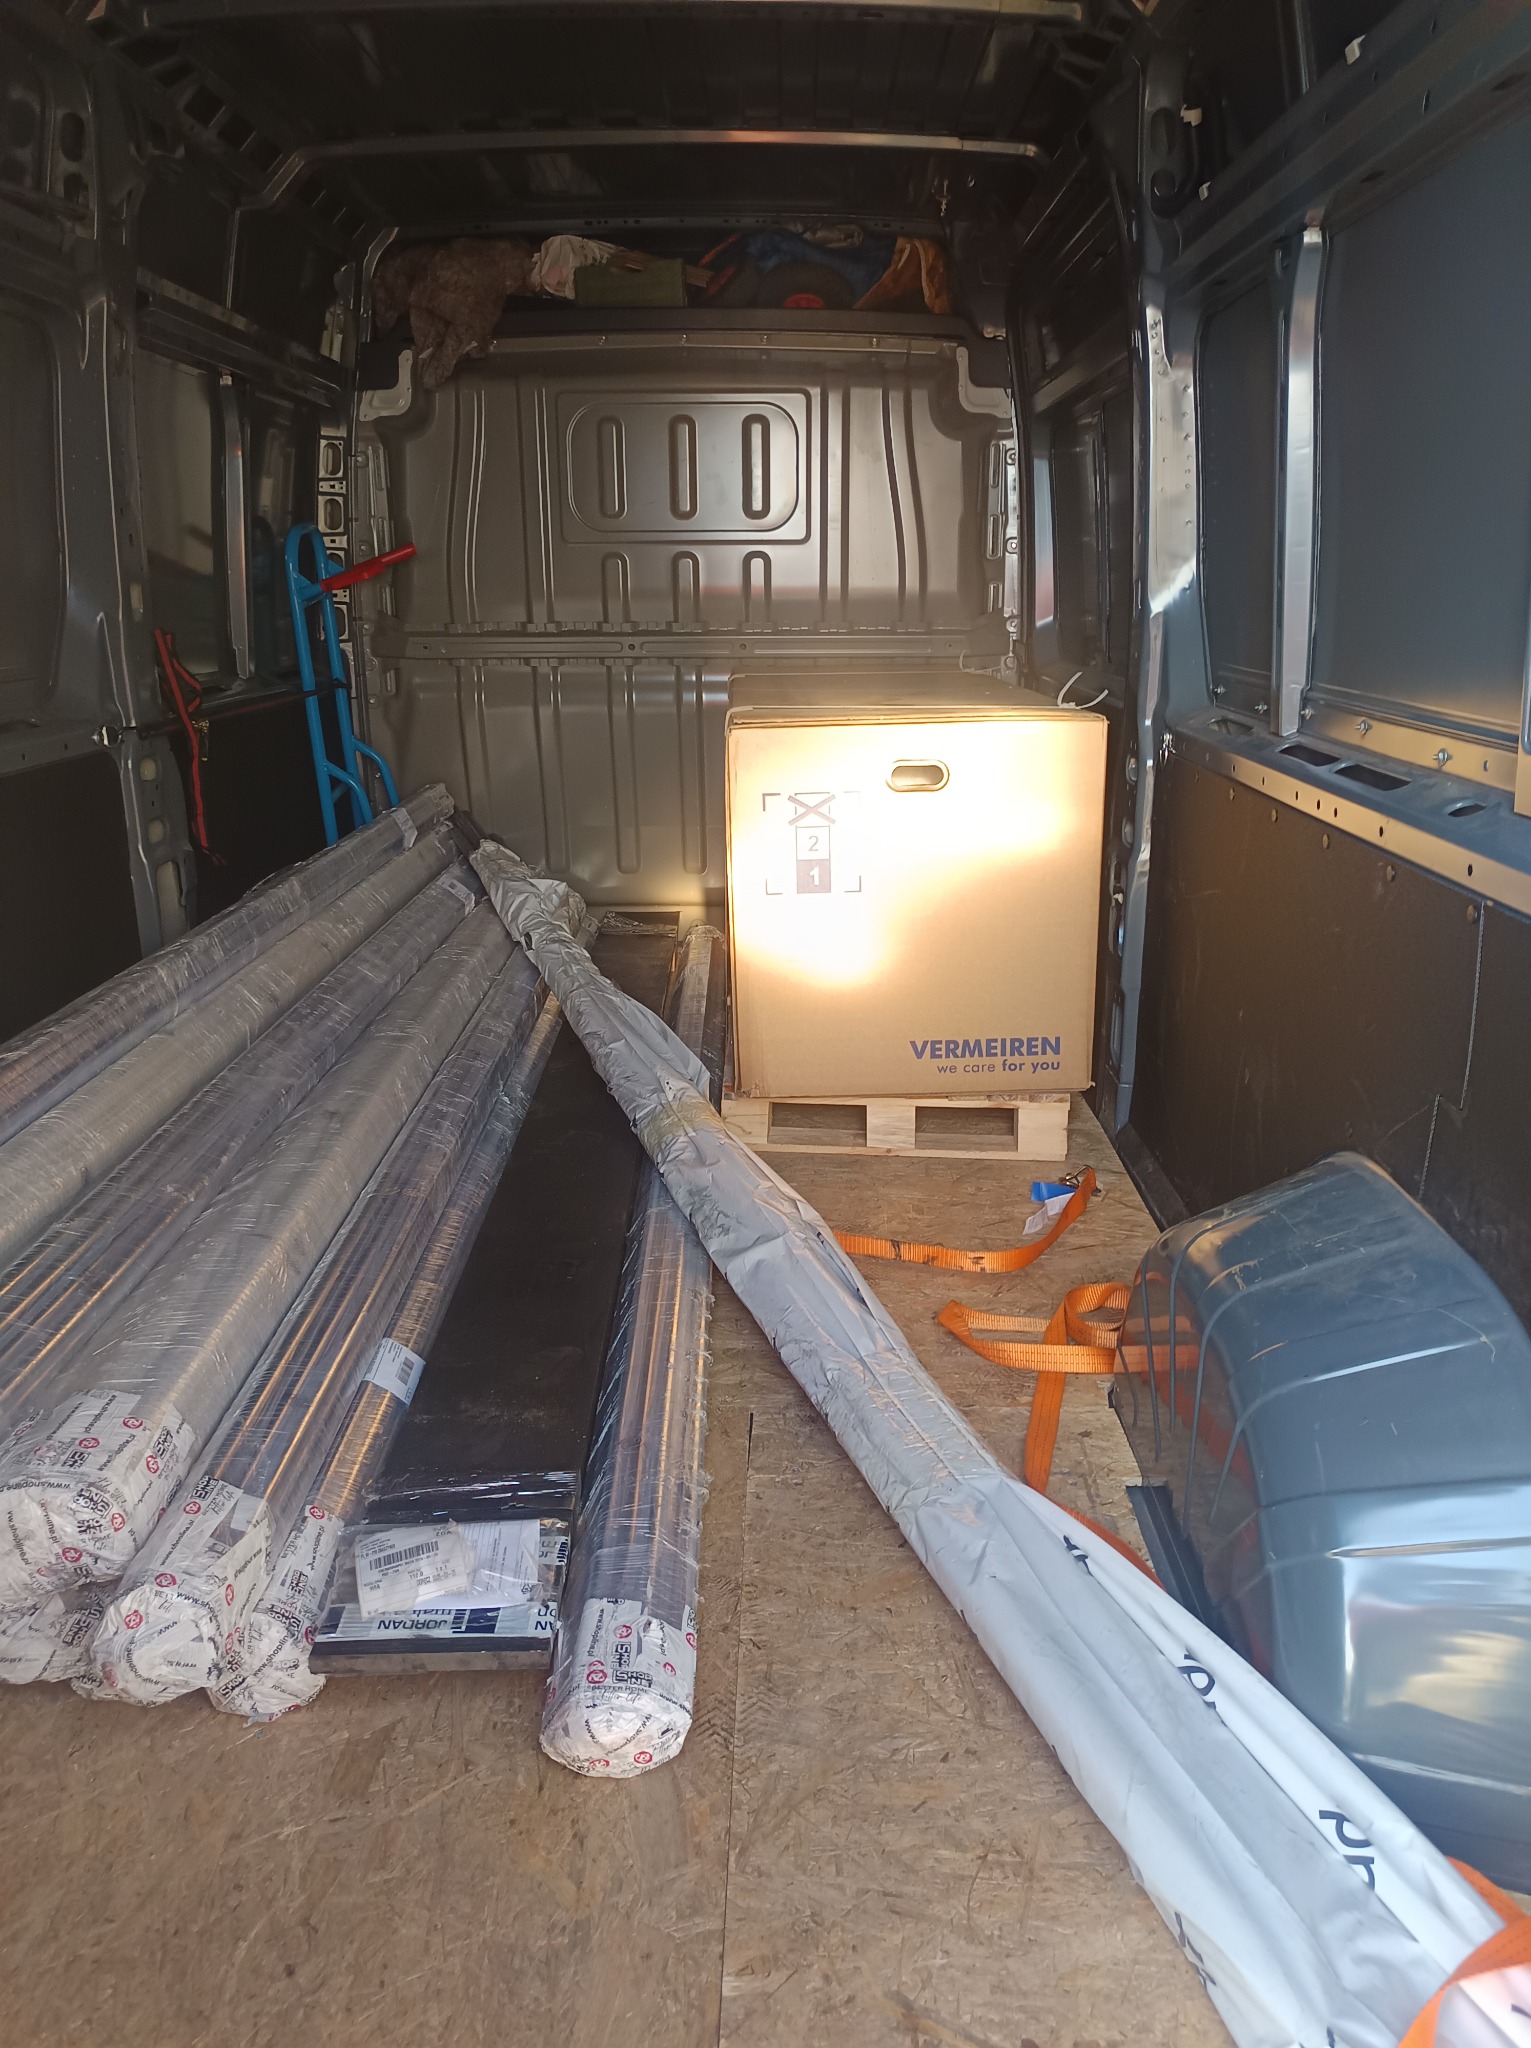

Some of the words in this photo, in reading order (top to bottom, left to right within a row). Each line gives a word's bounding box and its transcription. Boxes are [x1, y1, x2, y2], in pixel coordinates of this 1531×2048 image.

[808, 835, 819, 852] 2
[809, 865, 820, 887] 1
[909, 1036, 1061, 1060] VERMEIREN
[937, 1064, 957, 1074] we
[963, 1062, 996, 1073] care
[1002, 1059, 1025, 1072] for
[1031, 1061, 1061, 1074] you
[377, 1619, 448, 1629] JORDAN
[615, 1671, 653, 1681] SHOP
[219, 1673, 246, 1699] SHOP
